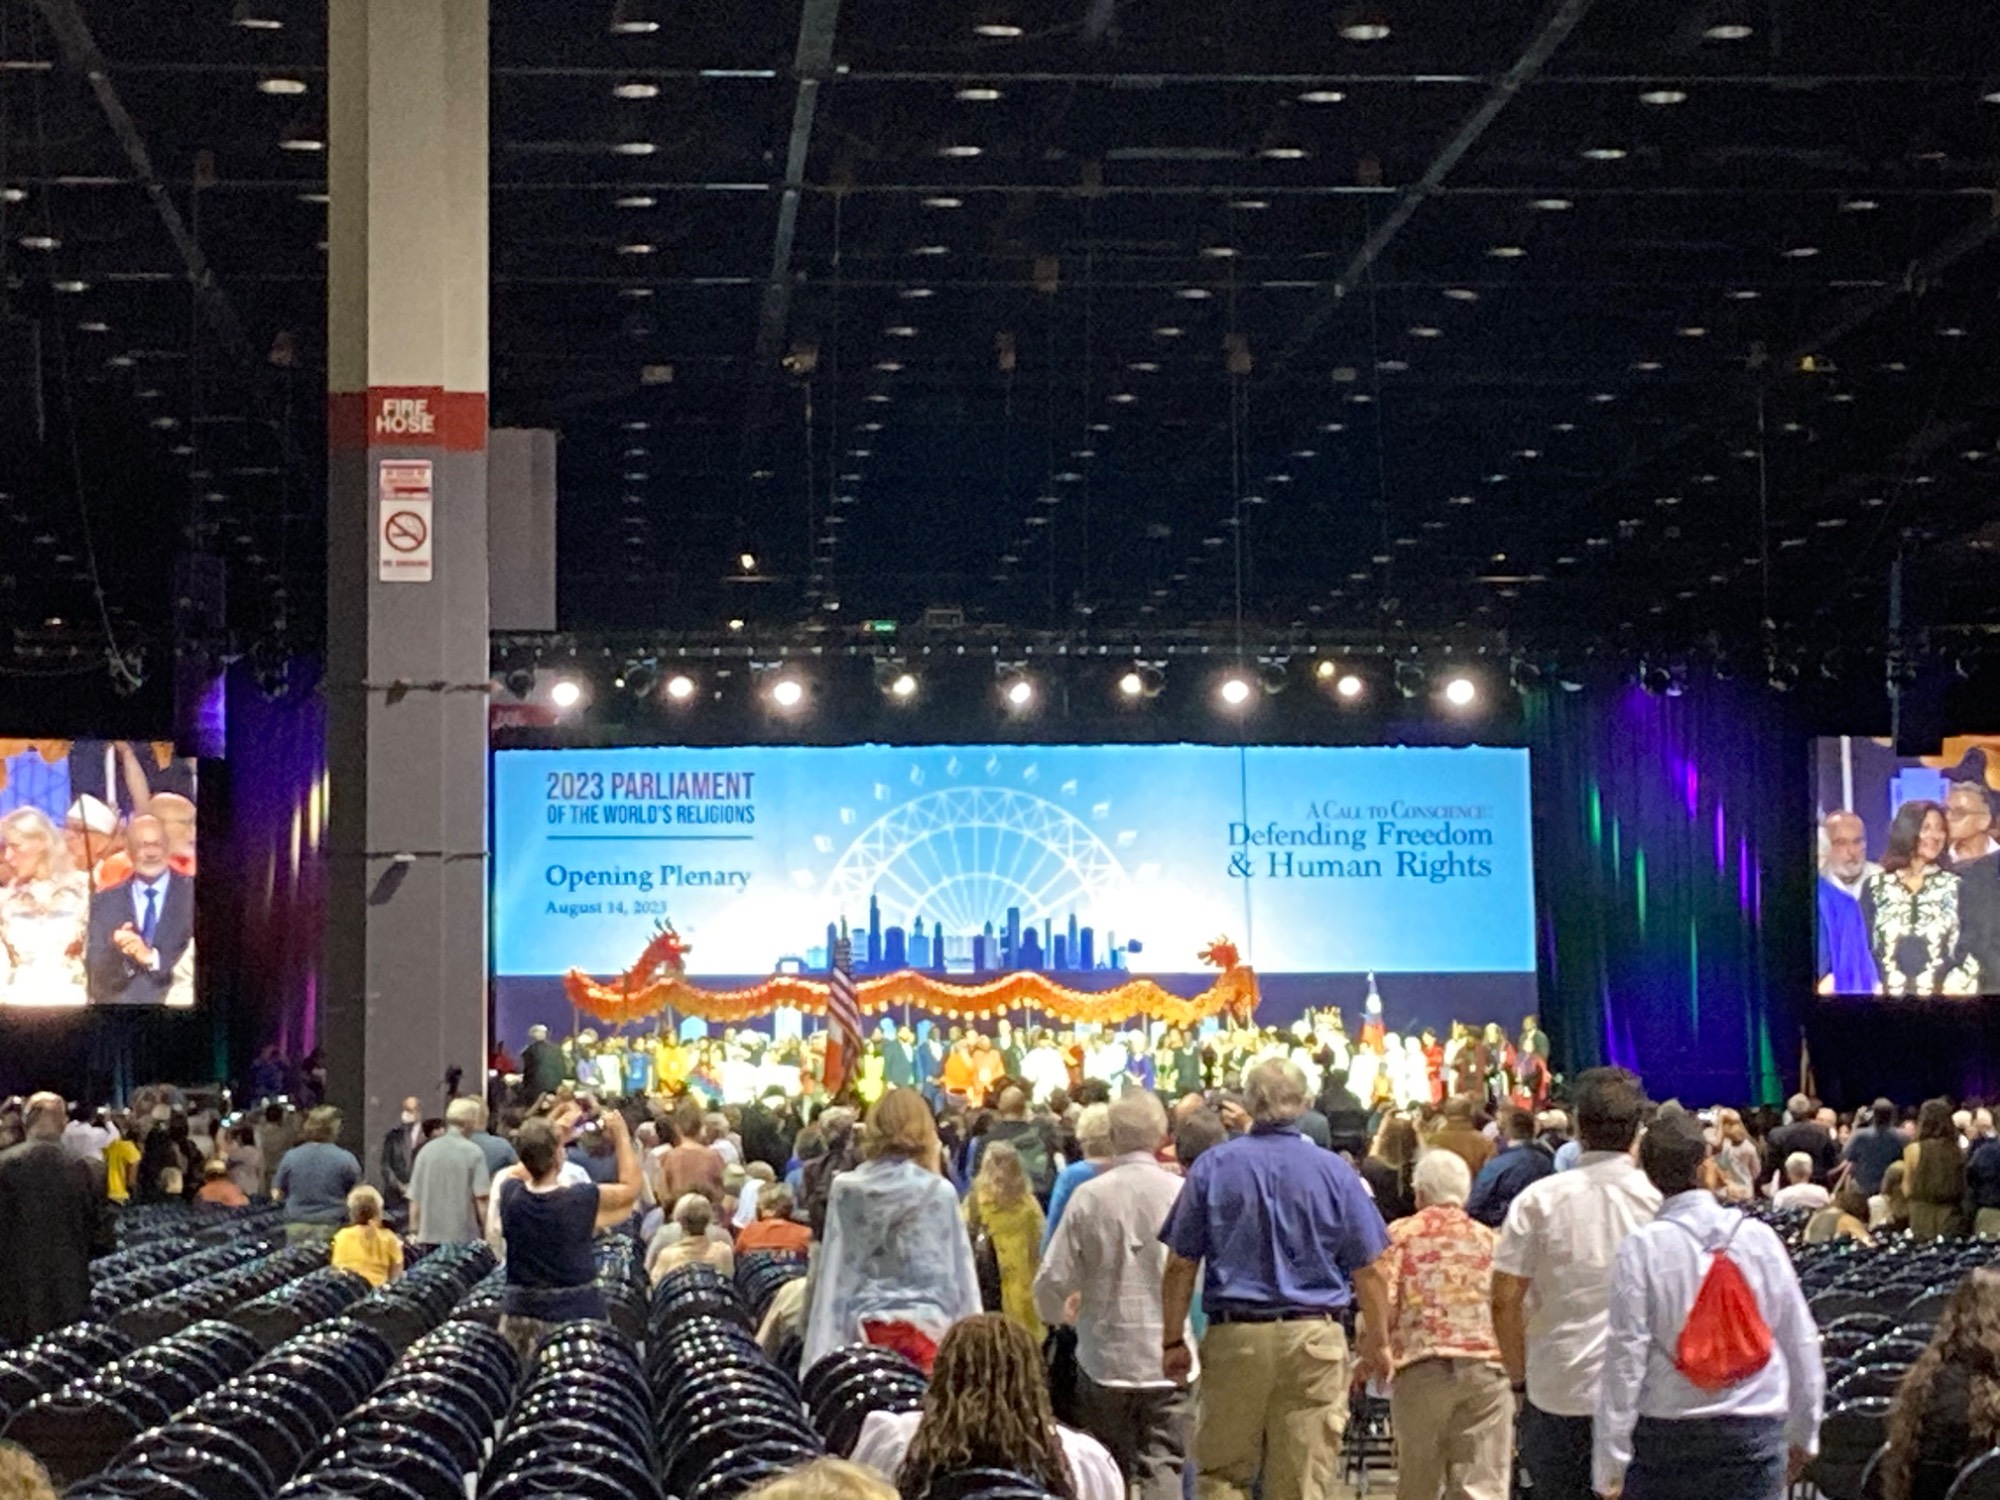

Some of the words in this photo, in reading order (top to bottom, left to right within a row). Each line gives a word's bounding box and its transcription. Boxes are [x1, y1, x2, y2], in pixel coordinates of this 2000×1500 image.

[383, 399, 428, 416] FIRE
[375, 415, 435, 433] HOSE
[546, 772, 604, 800] 2023
[611, 772, 755, 800] PARLIAMENT
[547, 804, 566, 824] OF
[570, 804, 599, 824] THE
[603, 804, 672, 824] WORLD'S
[677, 804, 755, 824] RELIGIONS
[1306, 800, 1320, 820] A
[1228, 821, 1367, 850] Defending
[1377, 821, 1493, 846] Freedom
[1227, 851, 1254, 878] &
[1268, 852, 1382, 877] Human
[1396, 850, 1492, 883] Rights
[545, 865, 653, 892] Opening
[660, 864, 751, 893] Plenary
[545, 901, 602, 917] August
[634, 901, 668, 915] 2023
